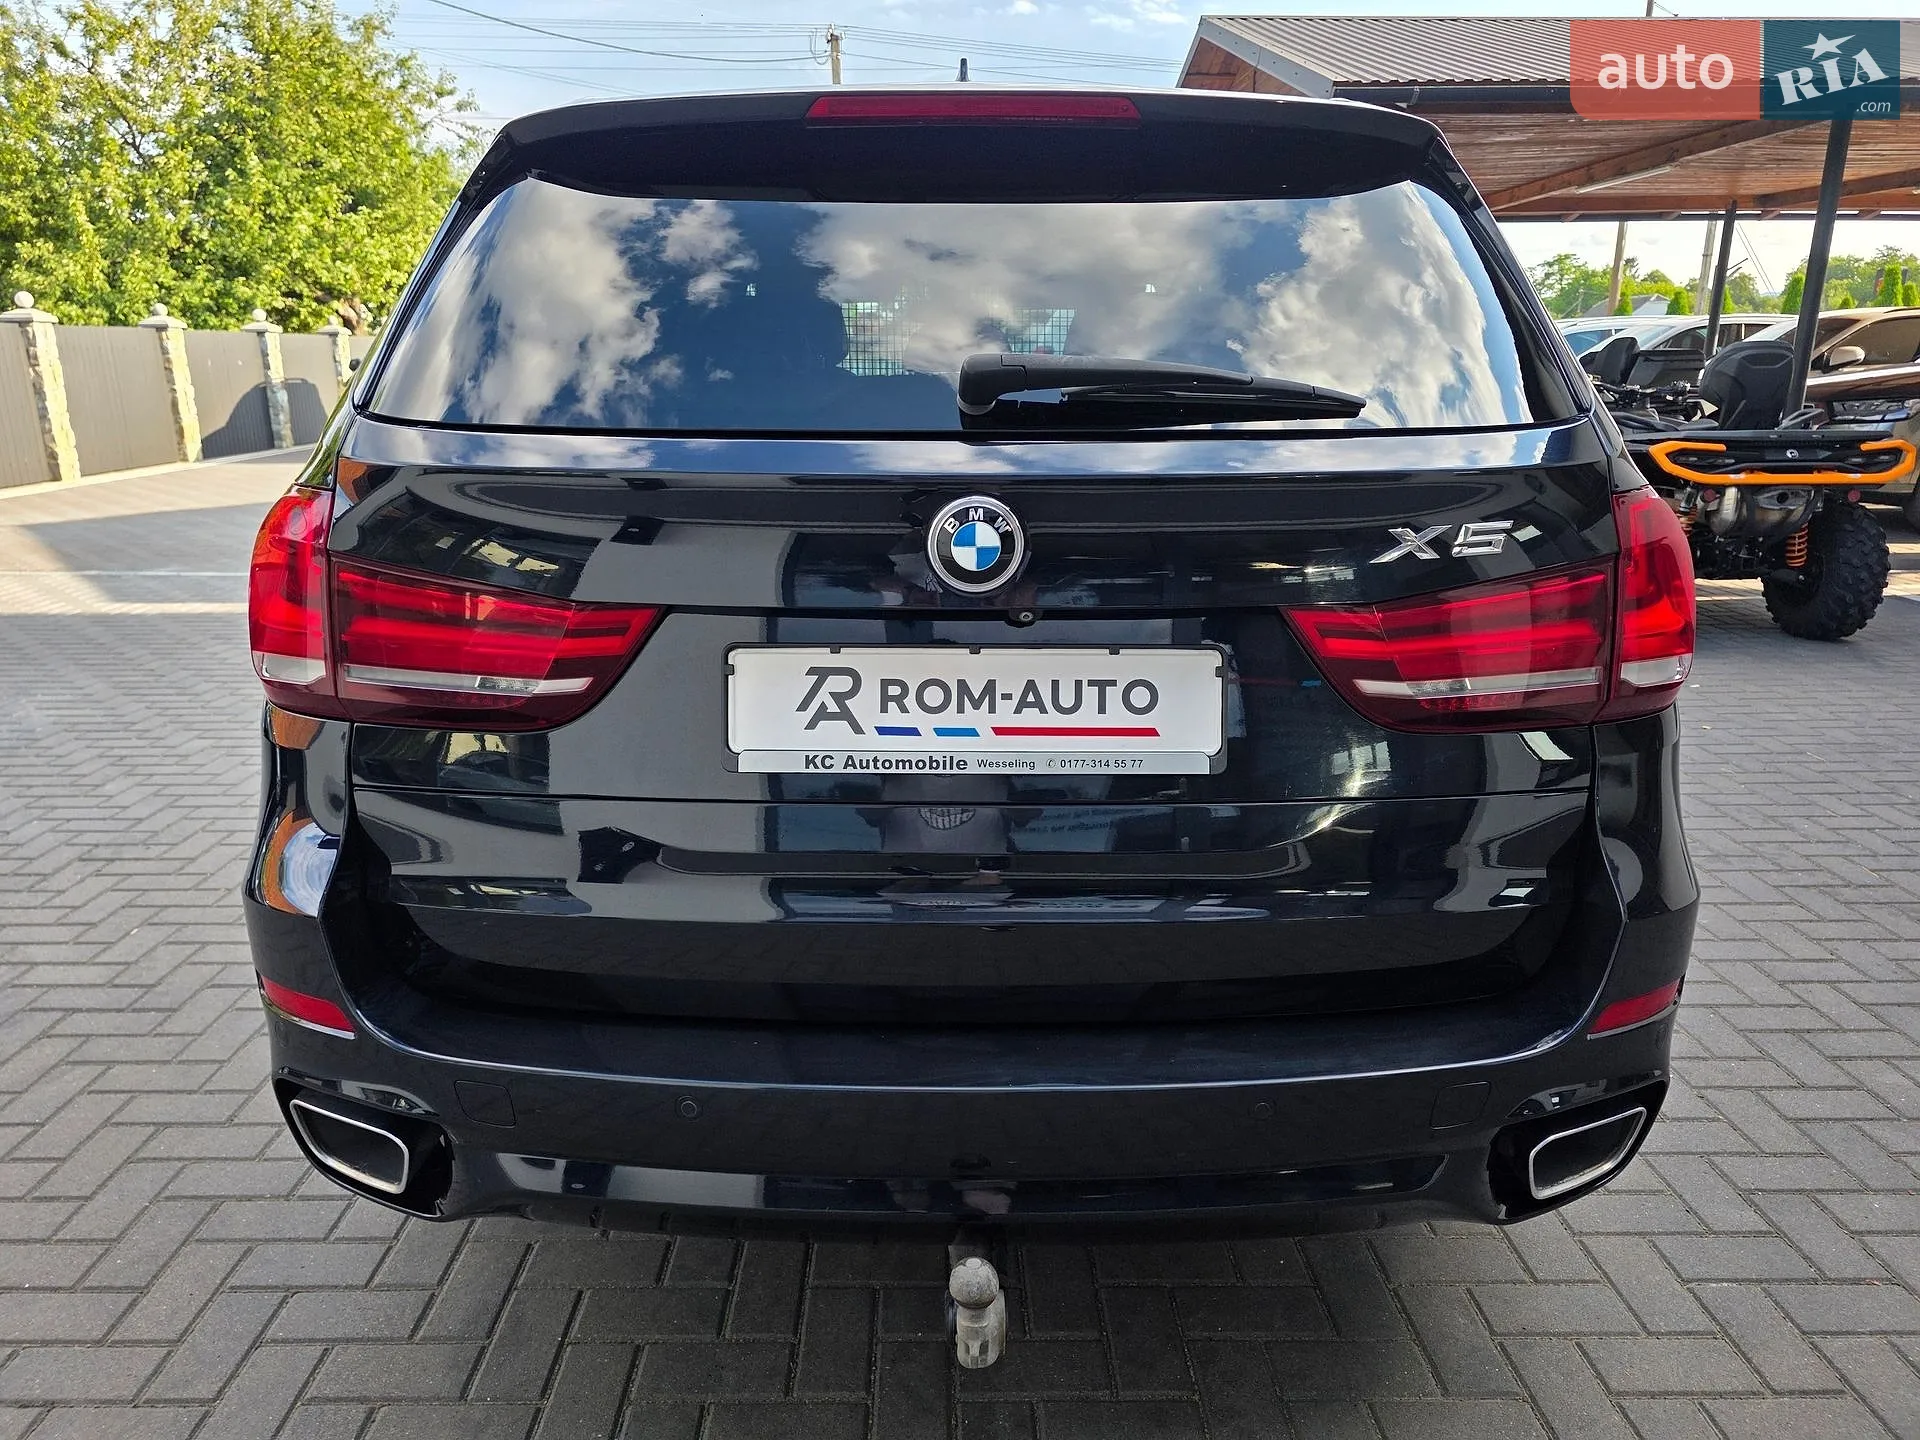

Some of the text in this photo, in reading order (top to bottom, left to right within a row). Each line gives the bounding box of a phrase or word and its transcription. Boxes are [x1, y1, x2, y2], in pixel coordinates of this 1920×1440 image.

[1368, 519, 1515, 564] X5
[879, 677, 1160, 716] ROM-AUTO
[804, 754, 1144, 771] KC Automobile Wesseling 0177-314 55 77
